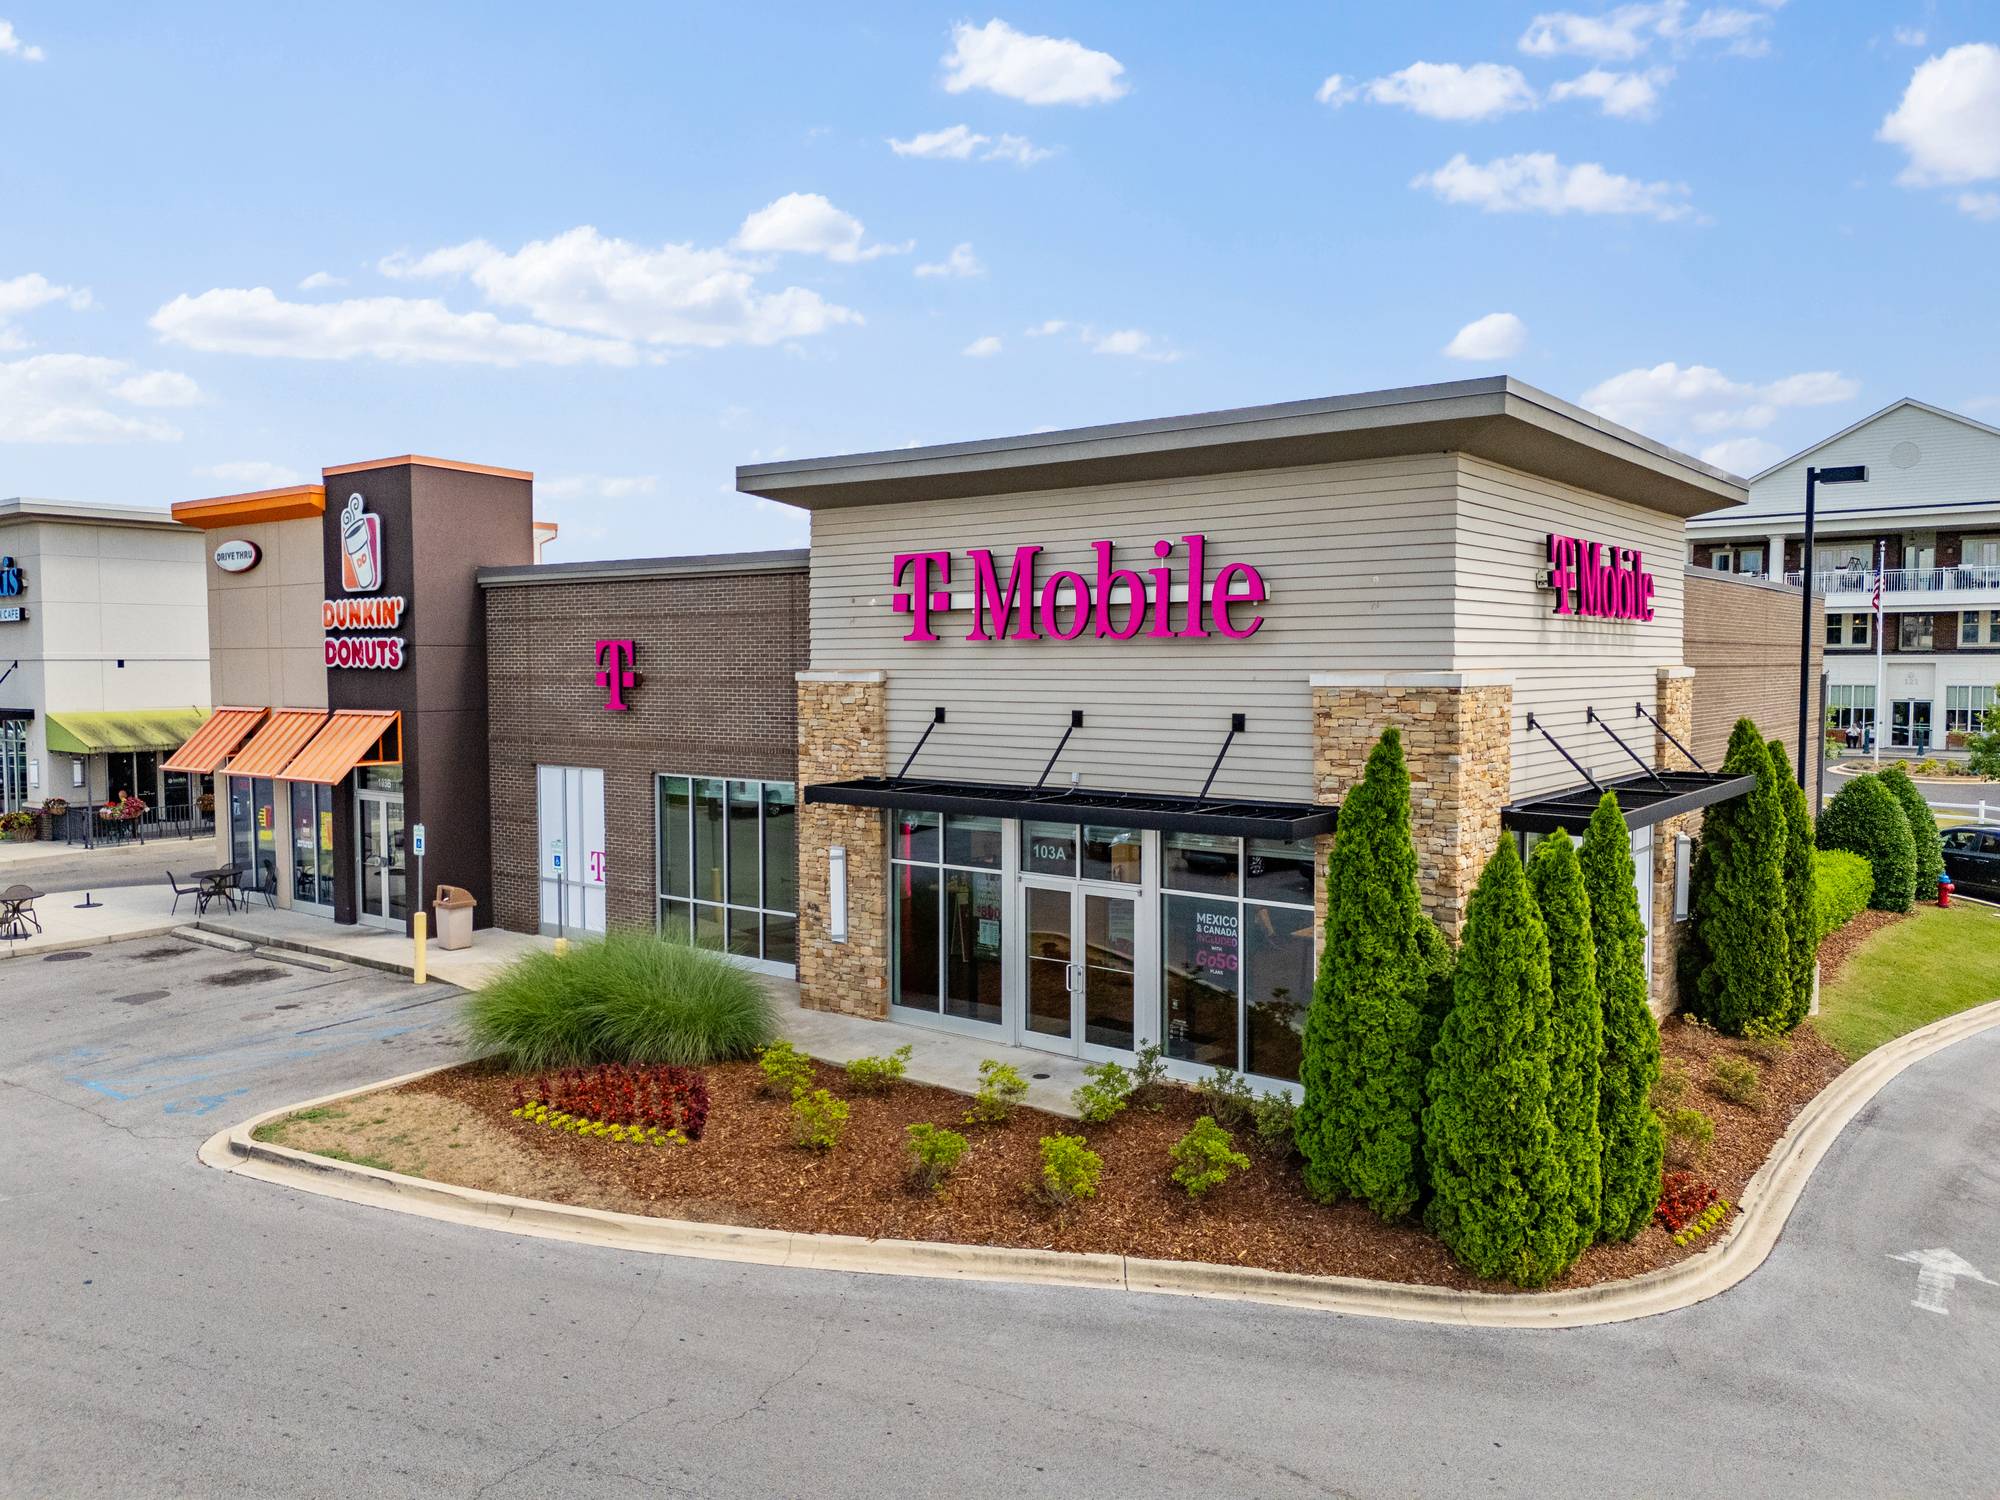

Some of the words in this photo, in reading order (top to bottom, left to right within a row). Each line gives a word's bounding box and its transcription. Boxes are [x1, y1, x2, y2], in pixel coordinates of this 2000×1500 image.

[216, 552, 235, 561] DRIVE
[236, 550, 252, 560] THRU
[4, 609, 19, 619] CAFE
[322, 598, 402, 630] DUNKIN'
[324, 638, 401, 668] DONUTS
[1033, 844, 1066, 860] 103A
[1196, 912, 1238, 928] MEXICO
[1196, 923, 1202, 933] &
[1203, 925, 1238, 937] CANADA
[1196, 933, 1238, 948] INCLUDED
[1196, 950, 1238, 971] Go5G
